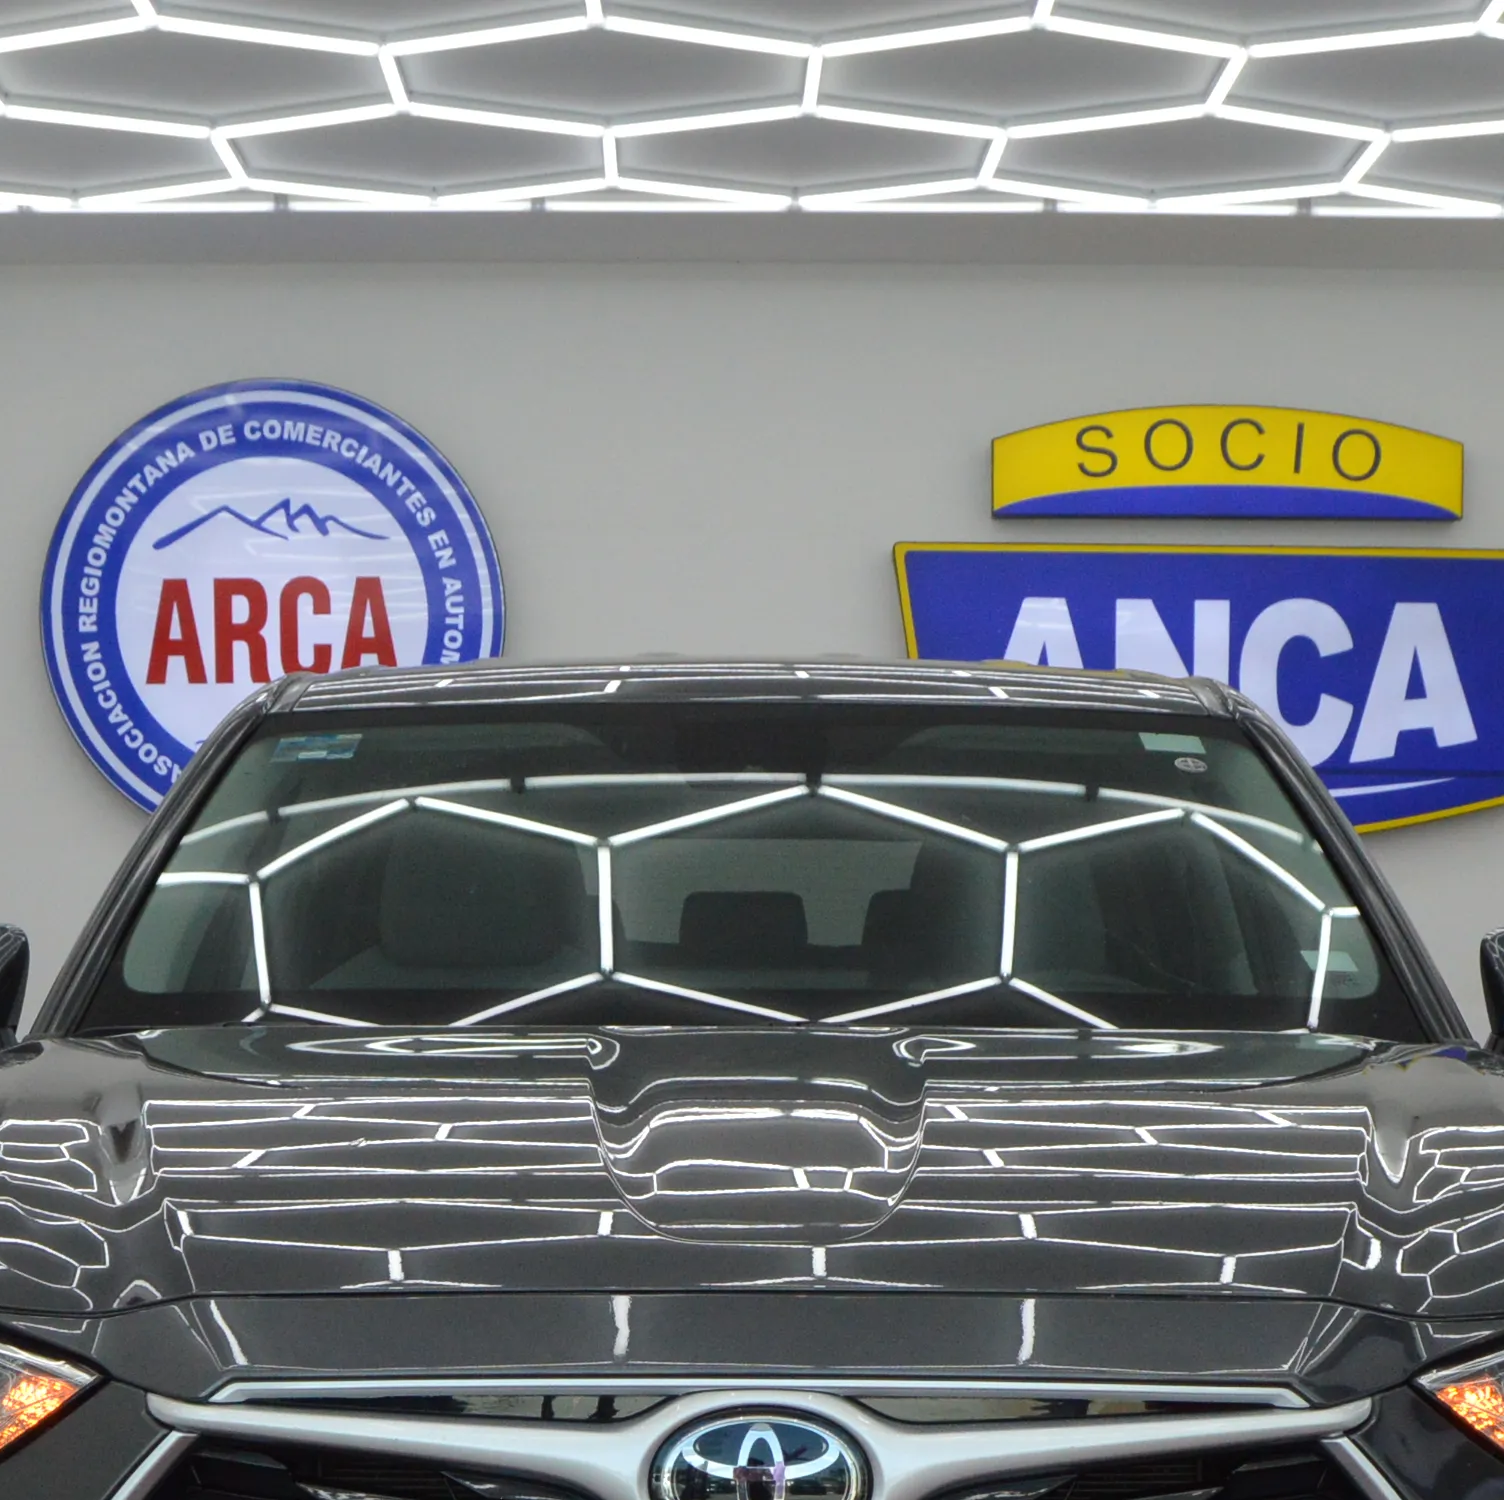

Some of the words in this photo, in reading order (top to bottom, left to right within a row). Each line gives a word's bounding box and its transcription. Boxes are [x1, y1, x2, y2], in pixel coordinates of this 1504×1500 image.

[1075, 418, 1382, 481] SOCIO
[78, 441, 196, 633] REGIOMONTANA
[198, 423, 236, 452] DE
[243, 419, 437, 528] COMERCIANTES
[427, 529, 457, 570] EN
[145, 575, 397, 685] ARCA
